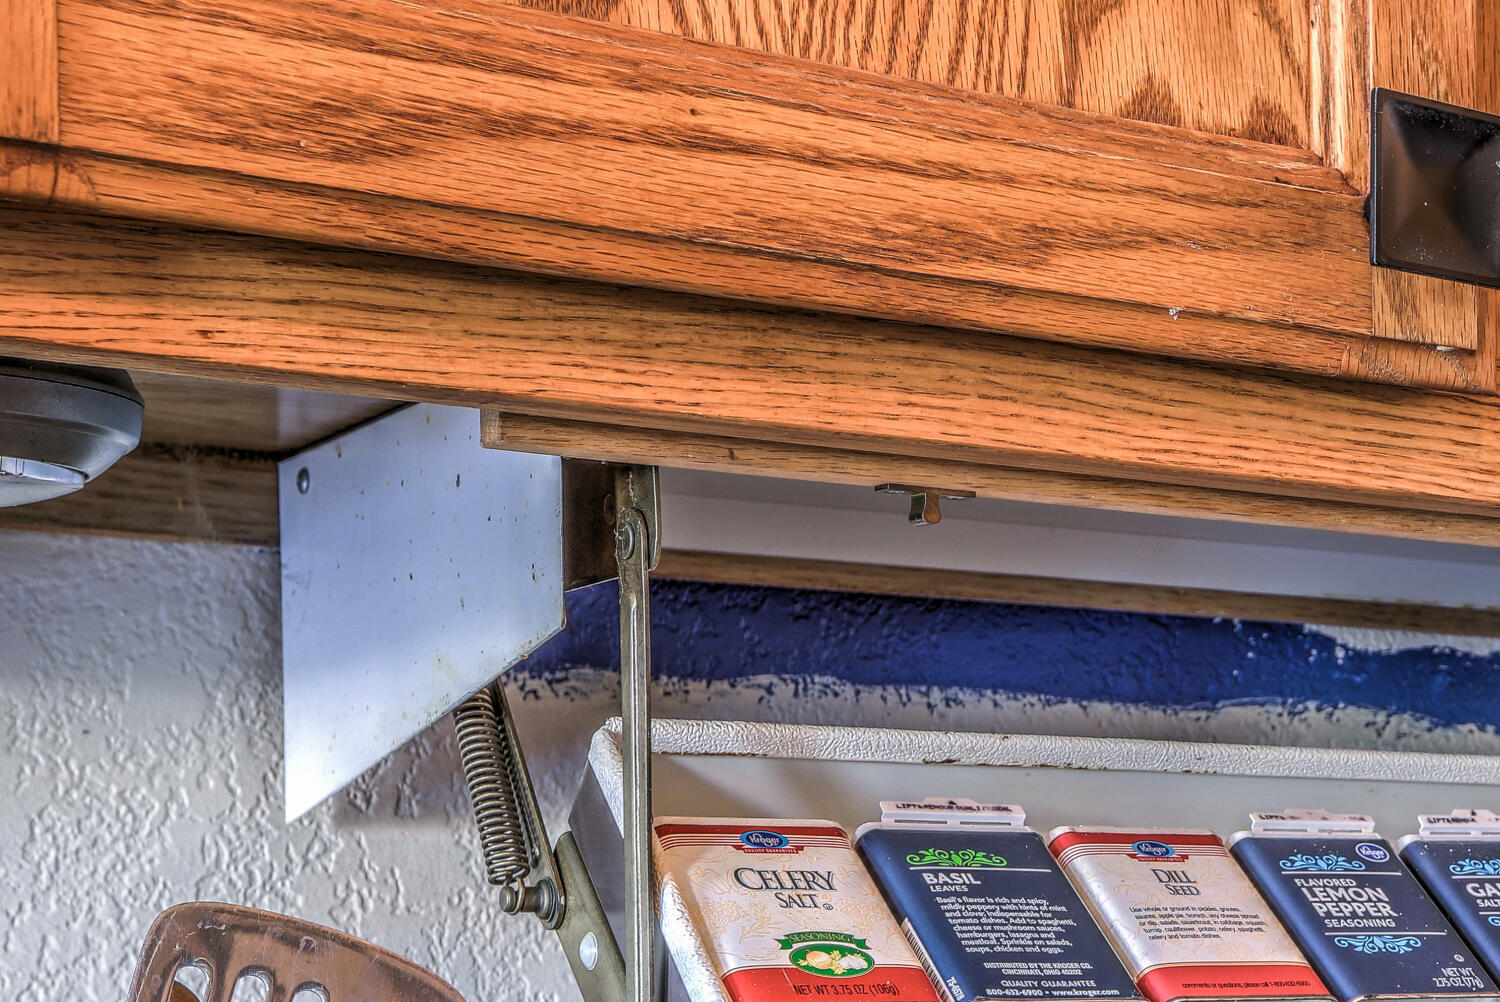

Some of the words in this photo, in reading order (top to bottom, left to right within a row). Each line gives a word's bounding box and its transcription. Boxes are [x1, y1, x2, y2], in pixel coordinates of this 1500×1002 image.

[748, 833, 780, 847] Kroger
[734, 867, 836, 891] CELERY
[922, 872, 981, 885] BASIL
[1151, 869, 1197, 884] DILL
[1294, 878, 1356, 887] FLAVORED
[1165, 884, 1200, 896] SEED
[1300, 887, 1390, 901] LEMON
[774, 892, 819, 909] SALT
[1312, 902, 1399, 917] PEPPER
[1324, 918, 1396, 928] SEASONING
[789, 931, 851, 943] SEASONING
[1441, 968, 1458, 977] NET
[1458, 968, 1476, 977] WT
[793, 985, 812, 996] NET
[814, 984, 828, 995] WT
[830, 984, 853, 995] 3.75
[855, 984, 868, 995] OZ
[869, 983, 900, 996] (106g)
[1051, 988, 1120, 997] www.kroger.com
